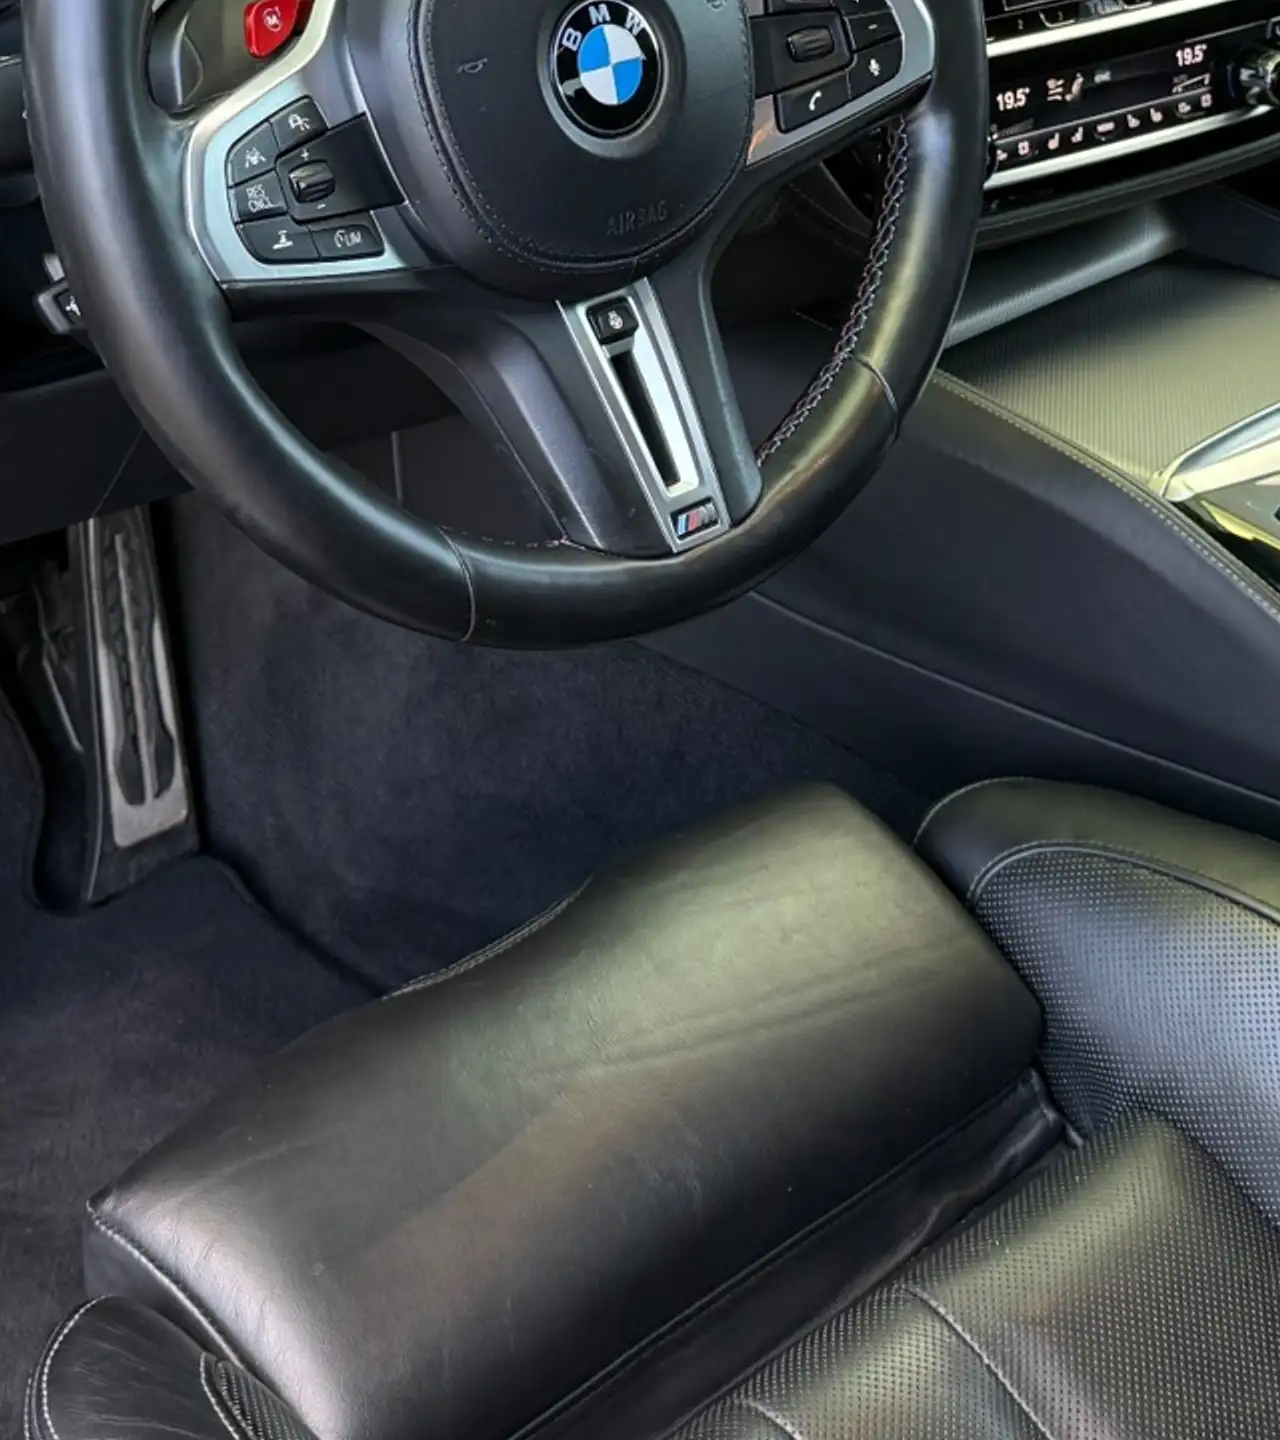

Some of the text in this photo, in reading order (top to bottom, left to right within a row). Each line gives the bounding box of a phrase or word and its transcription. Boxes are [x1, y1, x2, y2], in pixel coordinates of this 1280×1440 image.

[562, 3, 646, 52] BMW
[246, 184, 266, 199] RES
[606, 200, 668, 237] AIRBAG
